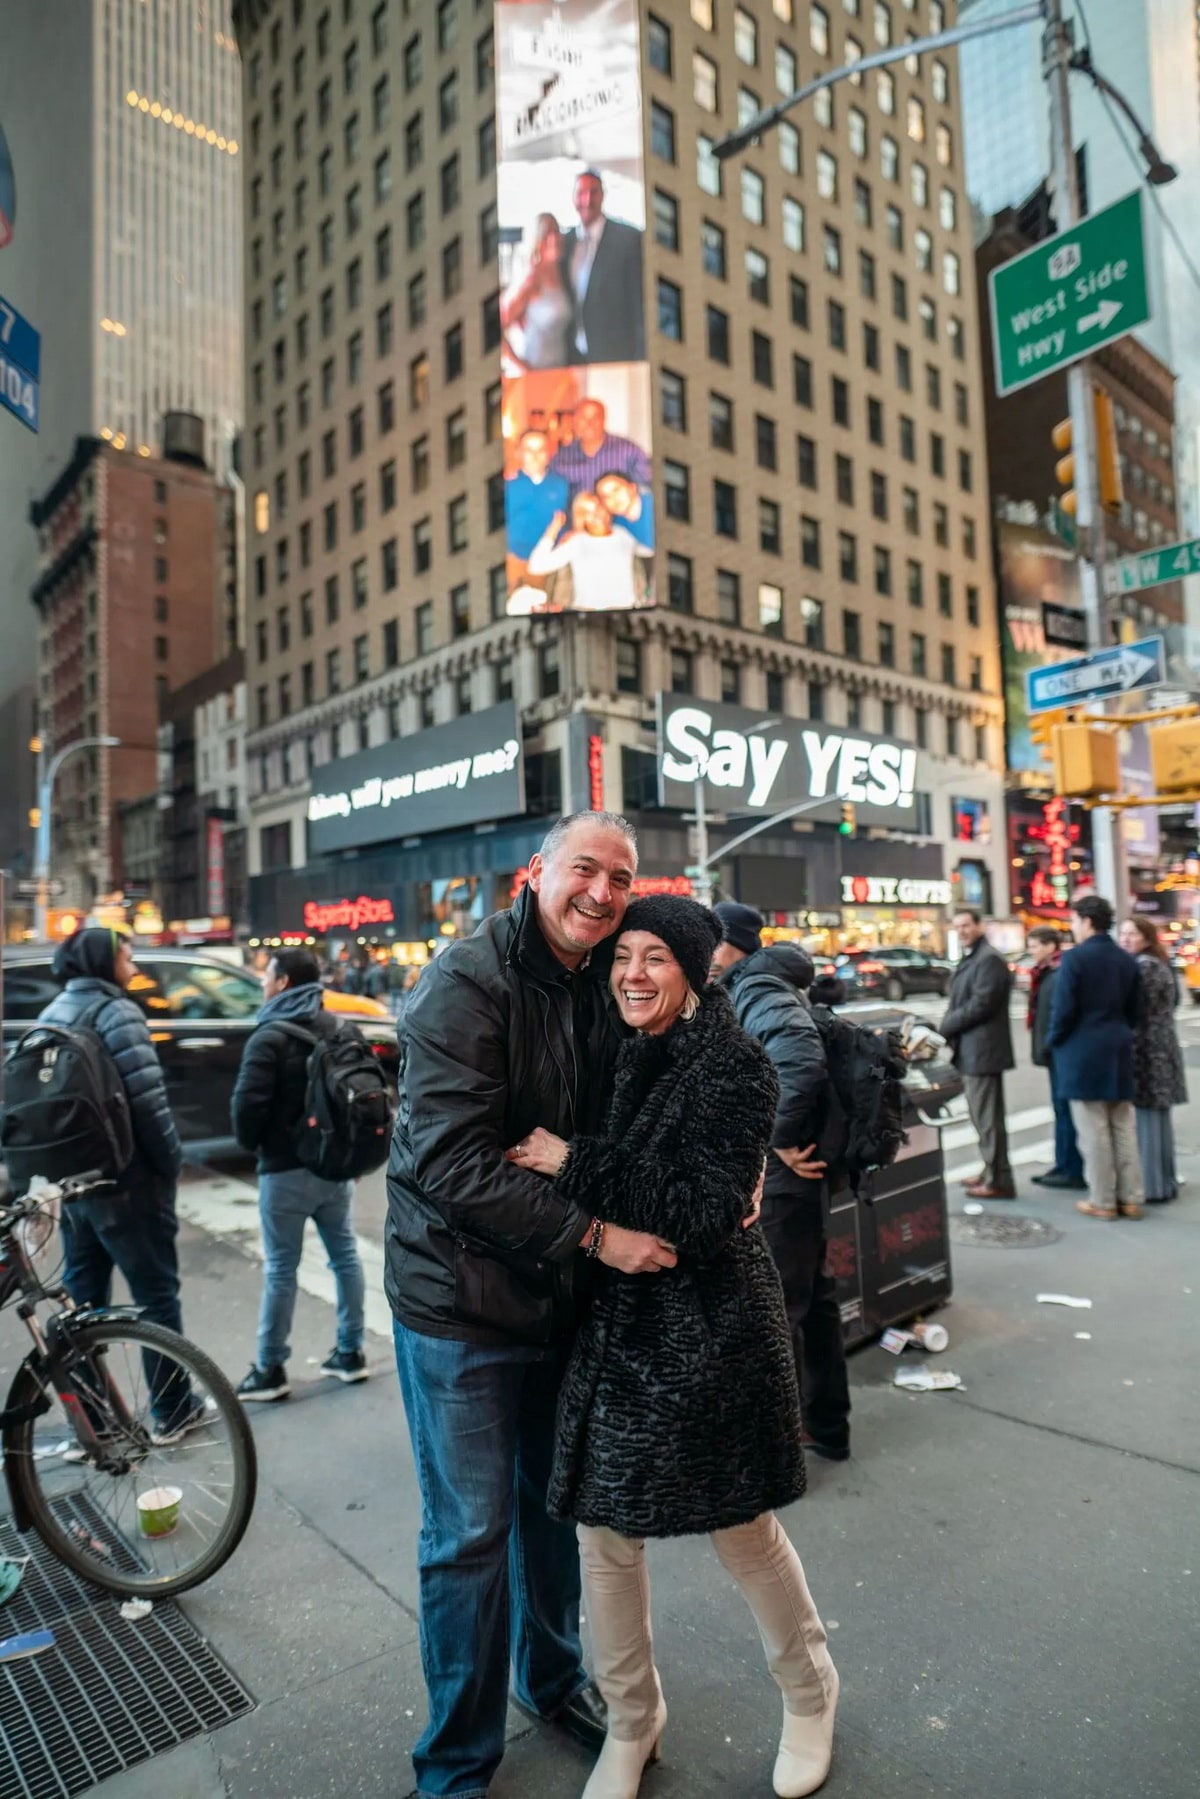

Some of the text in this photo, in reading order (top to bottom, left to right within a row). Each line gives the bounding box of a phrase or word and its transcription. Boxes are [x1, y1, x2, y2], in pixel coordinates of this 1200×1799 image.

[1011, 259, 1128, 335] West Side
[1018, 328, 1066, 368] Hwy
[1046, 660, 1139, 696] ONE WAY
[414, 758, 472, 789] marry
[472, 739, 519, 779] me?
[662, 707, 788, 807] Say
[802, 731, 917, 808] YES!
